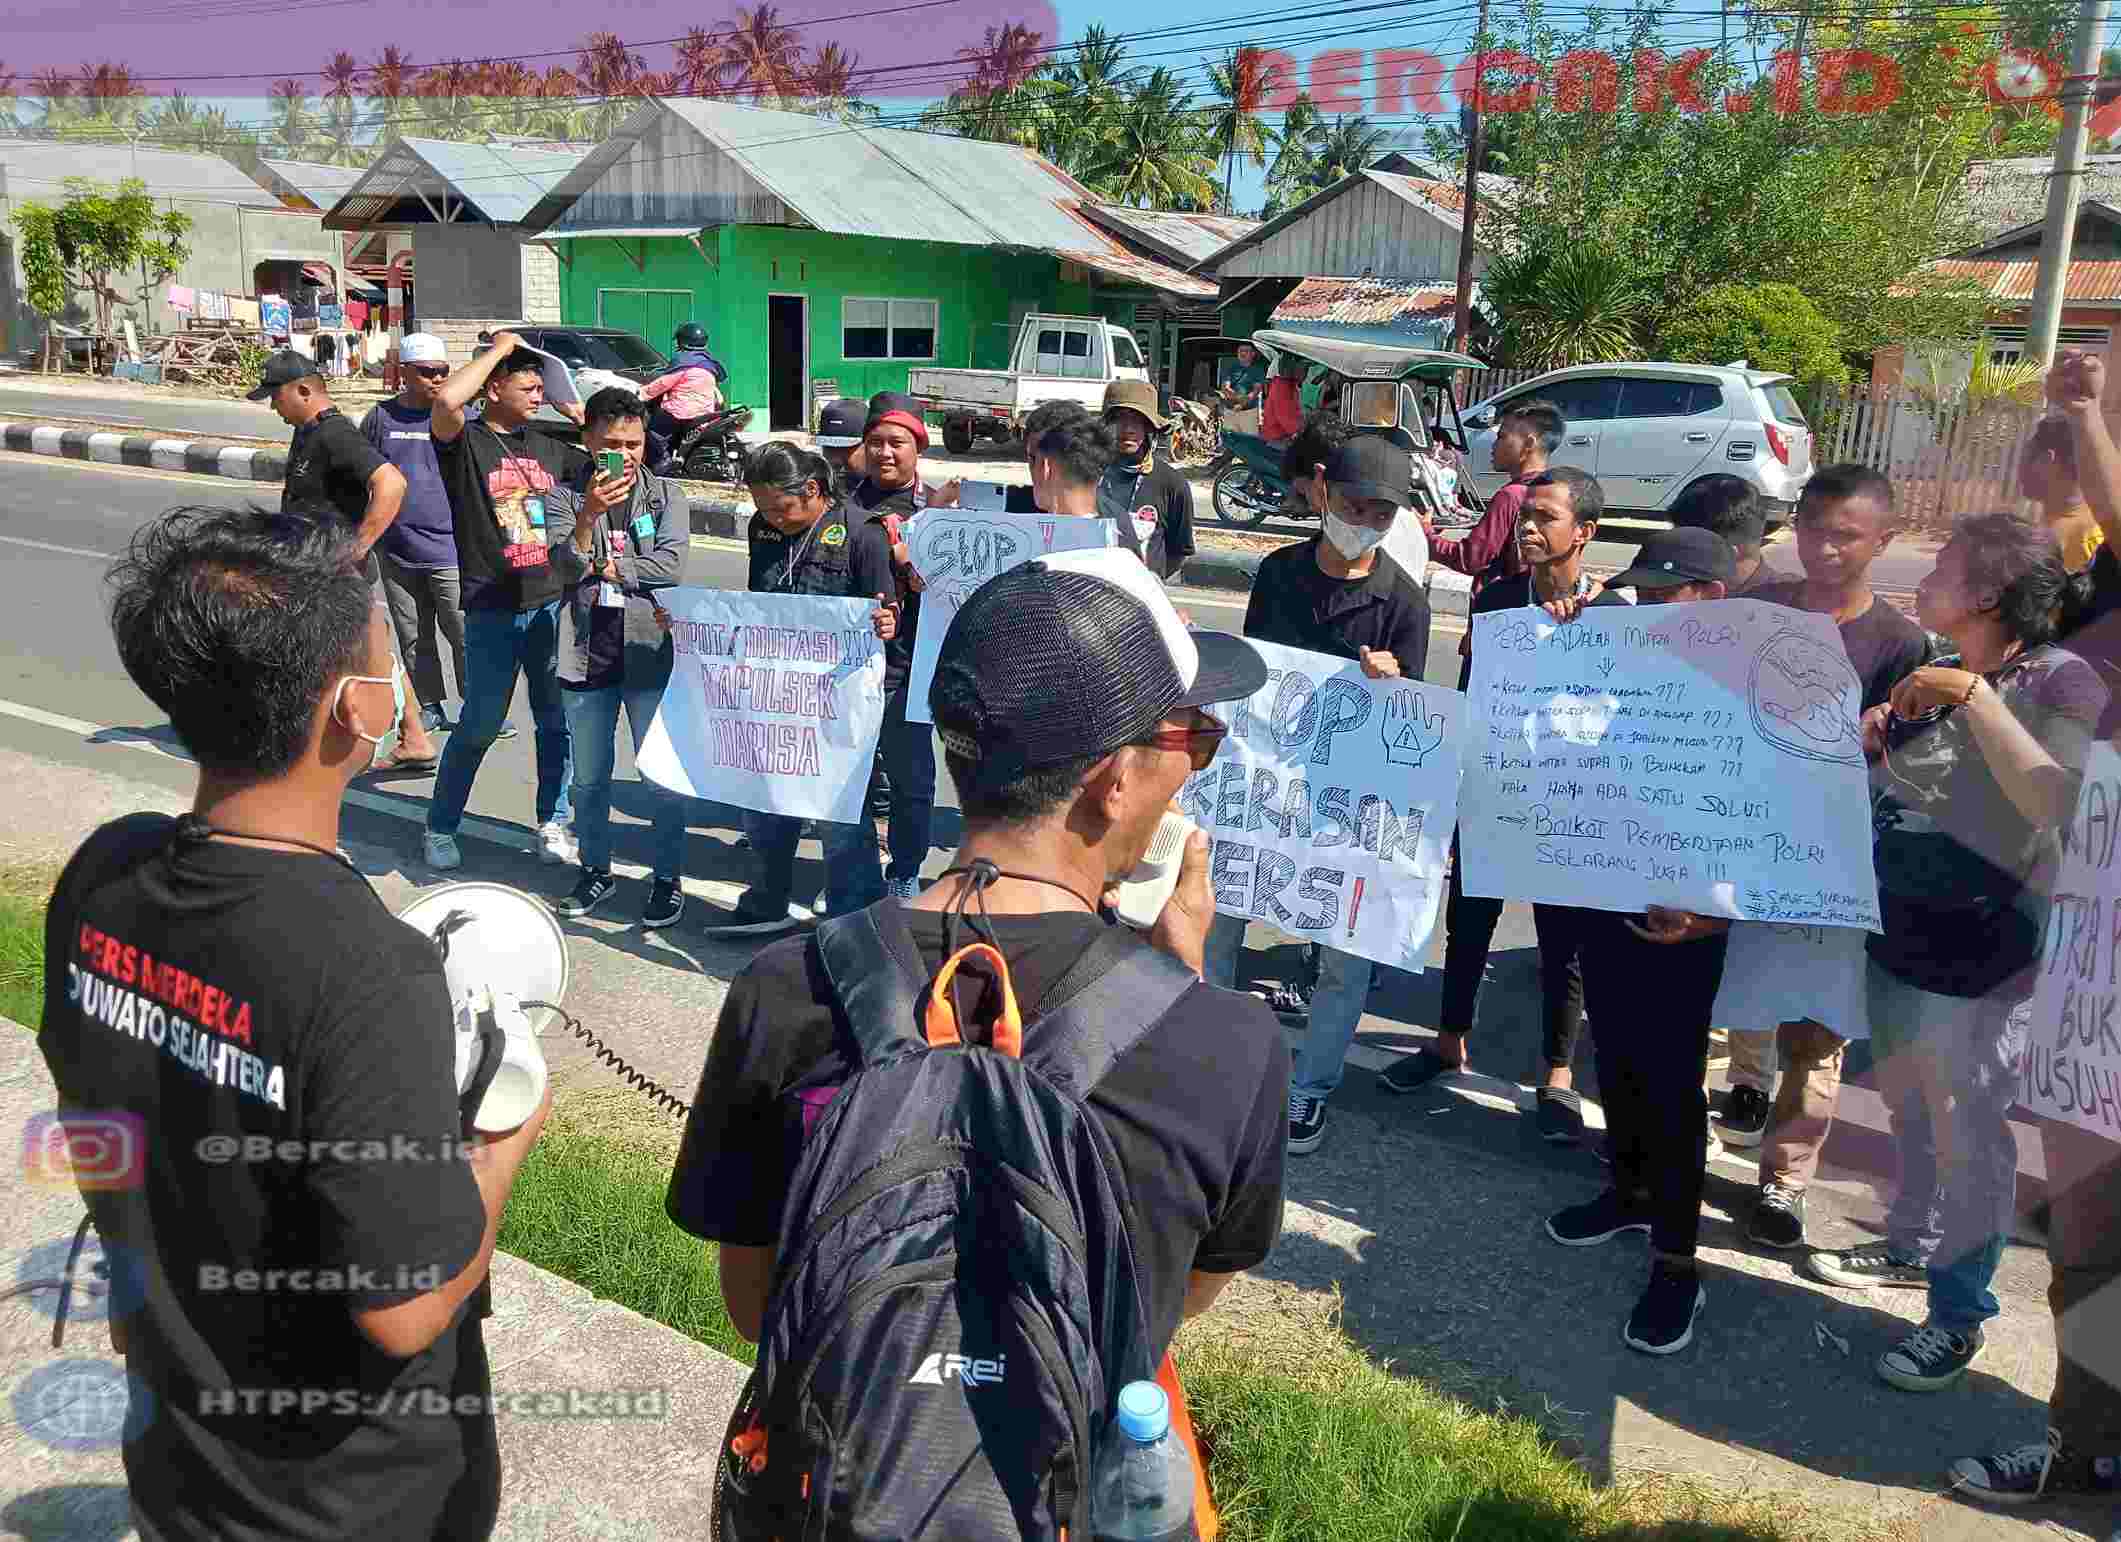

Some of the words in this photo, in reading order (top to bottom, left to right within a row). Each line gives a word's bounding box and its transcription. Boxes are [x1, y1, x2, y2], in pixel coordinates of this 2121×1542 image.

[711, 719, 821, 776] MARISA
[1763, 832, 1825, 864] POLRI
[141, 953, 254, 1046] MERDEKA
[170, 1015, 287, 1111] SEJAHTERA
